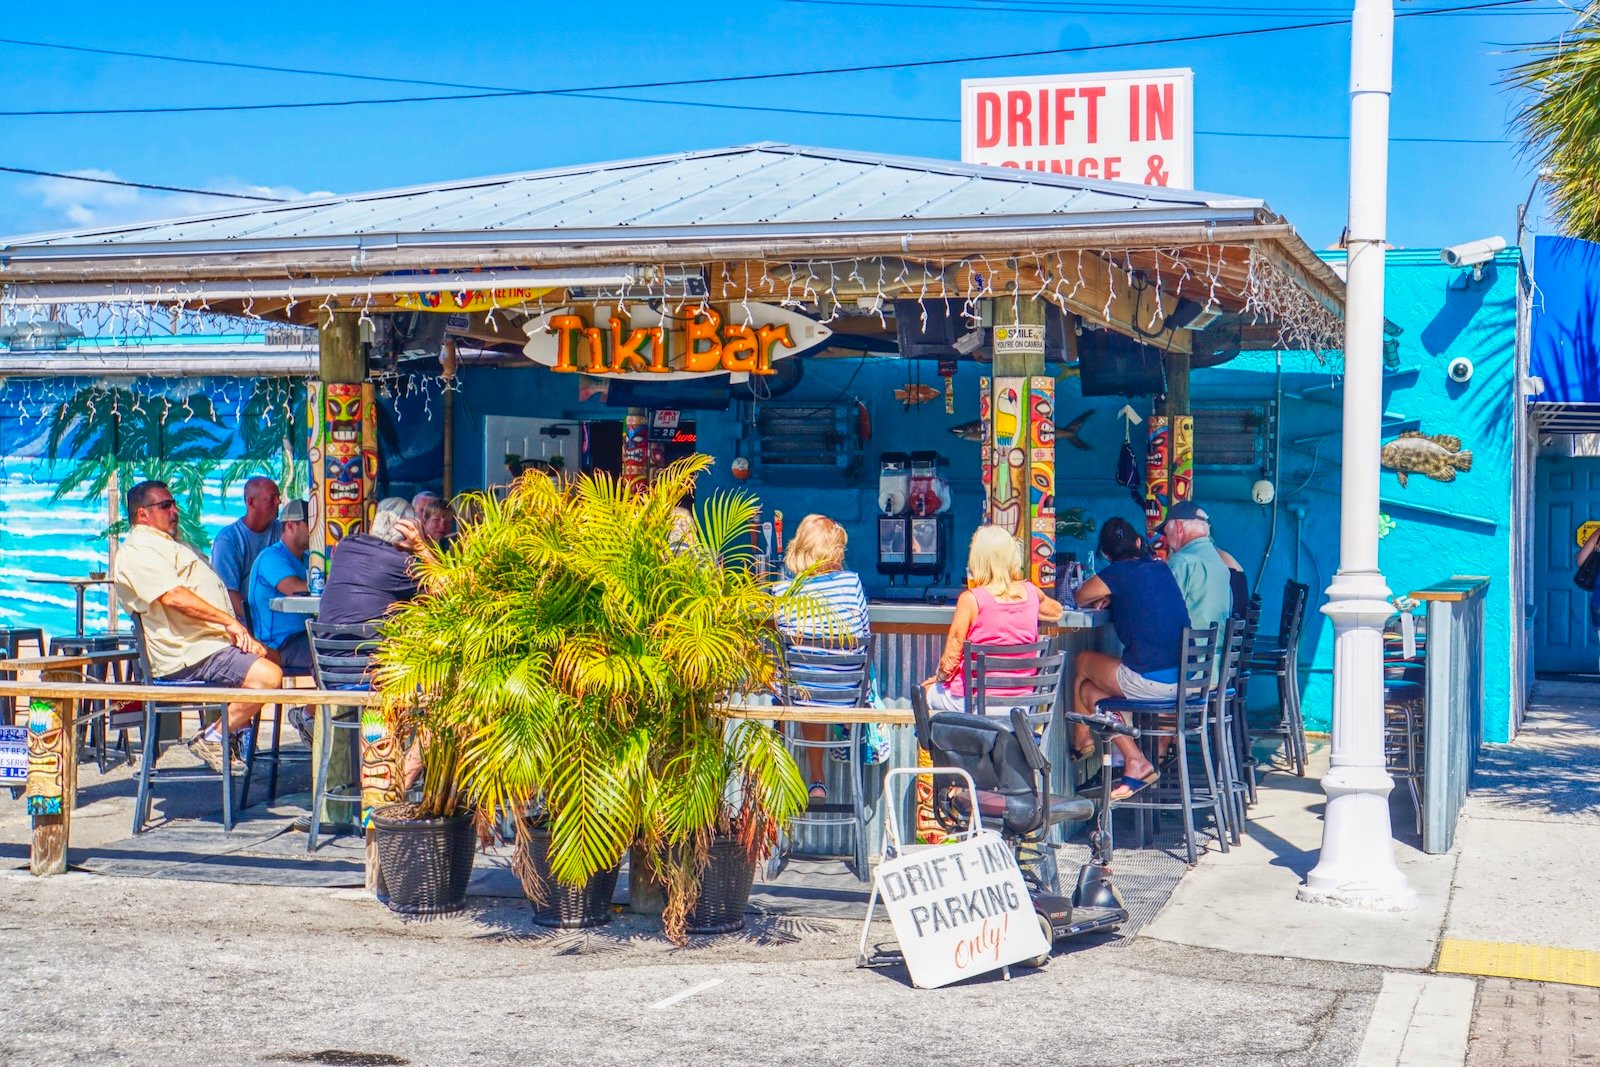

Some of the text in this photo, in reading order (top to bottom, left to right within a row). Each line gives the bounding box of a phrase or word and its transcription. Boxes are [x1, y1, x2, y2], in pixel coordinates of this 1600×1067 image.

[976, 83, 1174, 148] DRIFT IN
[1143, 154, 1169, 187] &
[550, 305, 797, 375] Tiki Bar
[662, 428, 675, 437] 28
[6, 758, 28, 766] SERVE
[909, 880, 1020, 938] PARKING
[954, 911, 1009, 969] Only!
